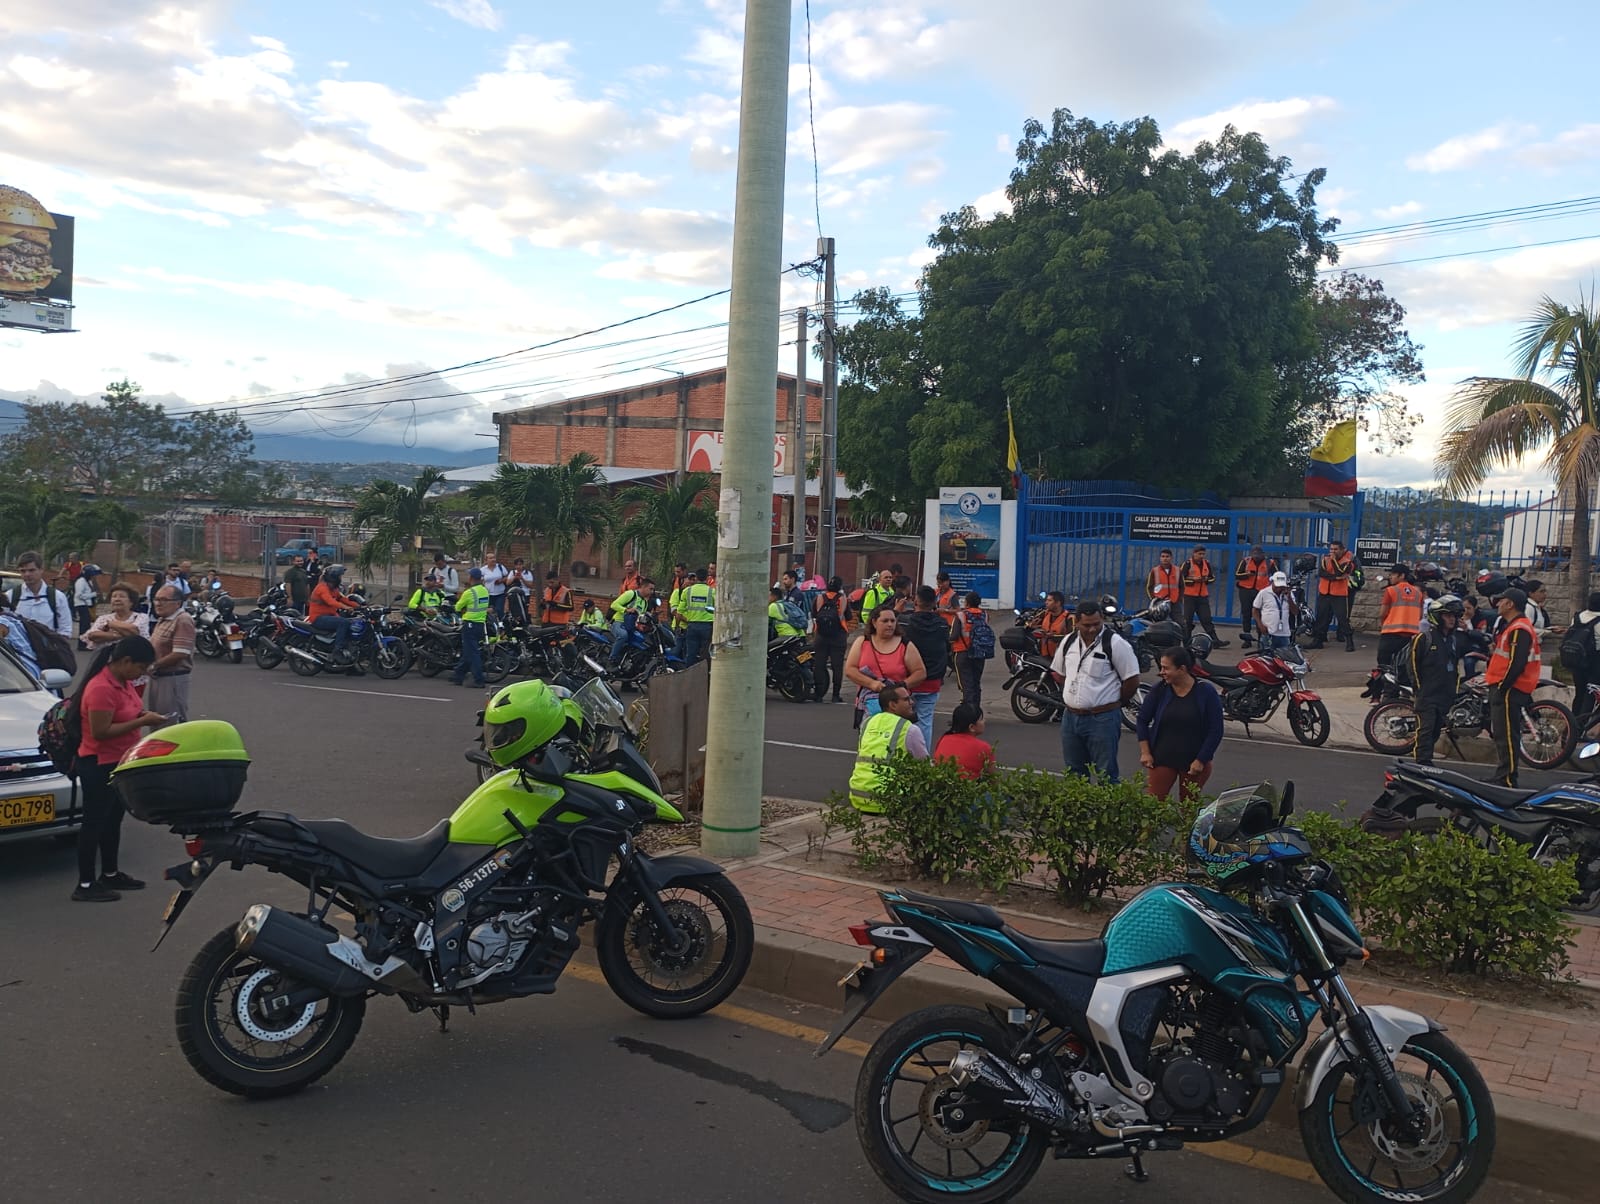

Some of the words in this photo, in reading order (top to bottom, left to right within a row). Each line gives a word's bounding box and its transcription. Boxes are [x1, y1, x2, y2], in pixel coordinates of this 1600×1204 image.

[1134, 515, 1149, 523] CALLE
[458, 859, 499, 893] 56-1375
[1368, 1040, 1394, 1081] YAMAHA
